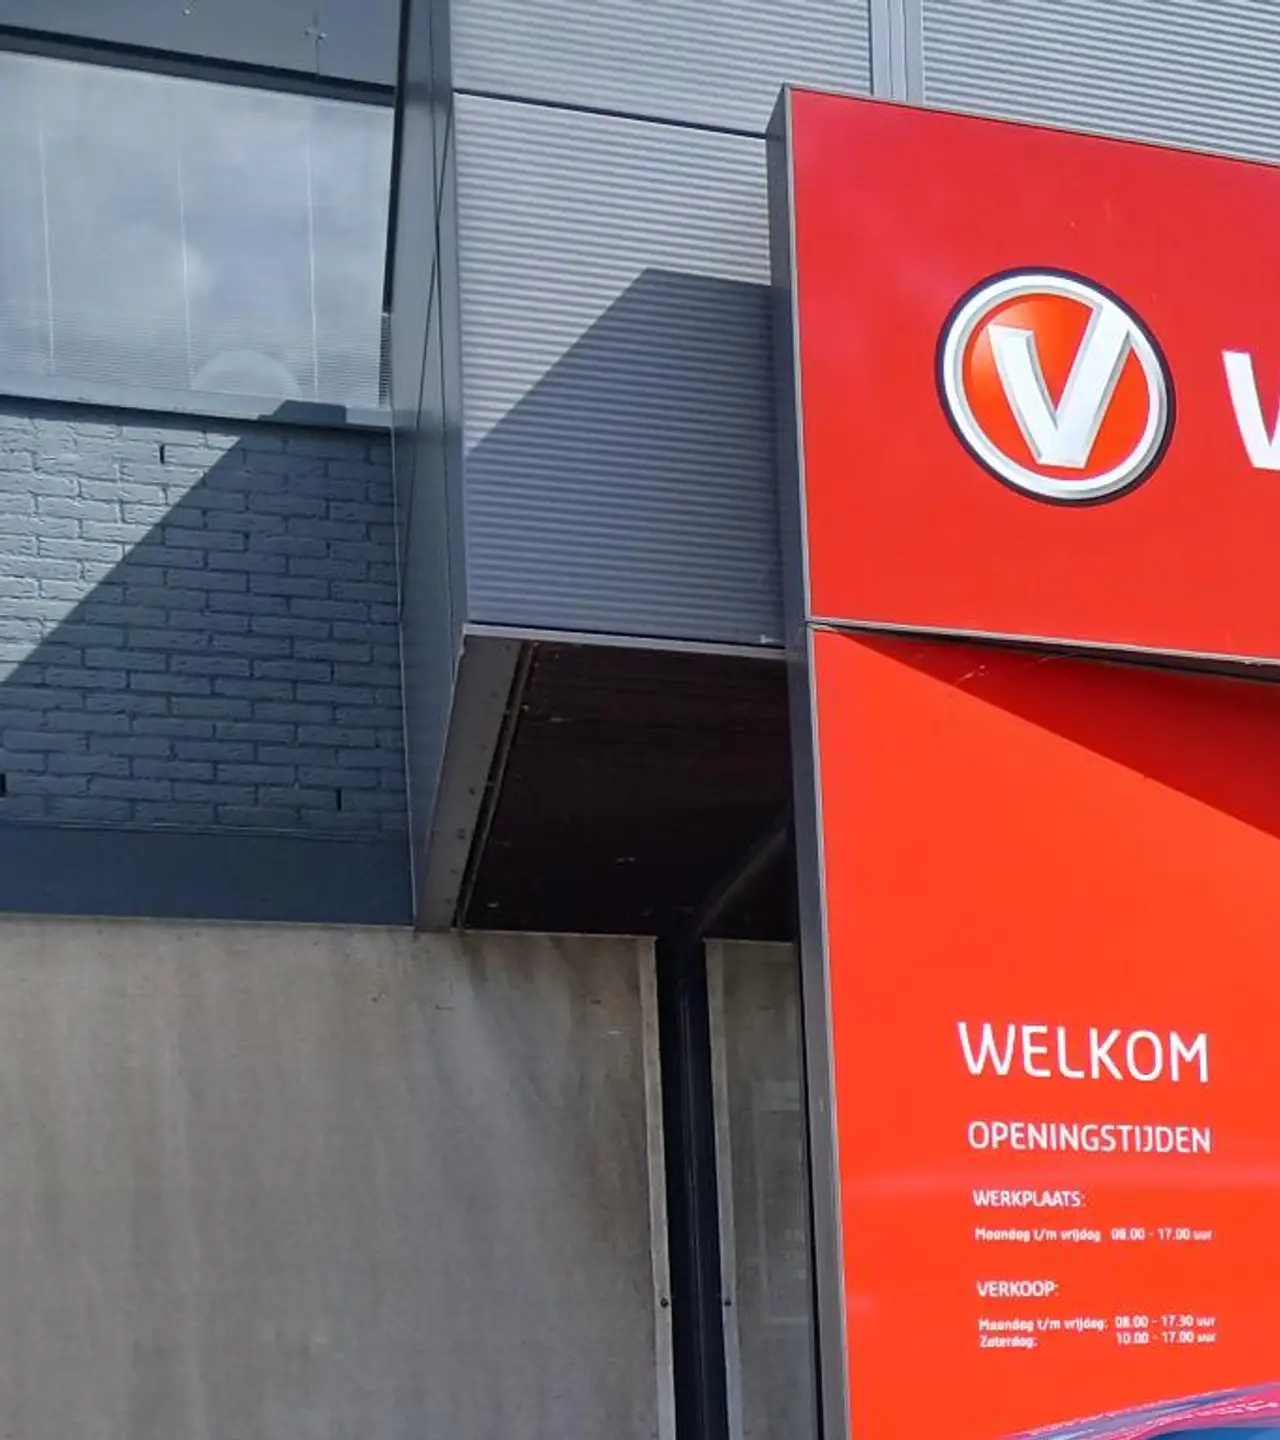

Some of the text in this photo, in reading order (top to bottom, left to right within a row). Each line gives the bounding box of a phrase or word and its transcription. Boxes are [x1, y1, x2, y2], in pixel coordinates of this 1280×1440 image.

[957, 1021, 1209, 1083] WELKOM
[968, 1121, 1211, 1153] OPENINGSTIJDEN
[975, 1227, 1030, 1243] Maandag
[1034, 1227, 1057, 1241] t/m
[1193, 1229, 1213, 1241] uur
[978, 1318, 1034, 1333] Maandag
[1037, 1317, 1061, 1330] t/m
[1196, 1315, 1216, 1327] uur
[1197, 1332, 1217, 1343] uur
